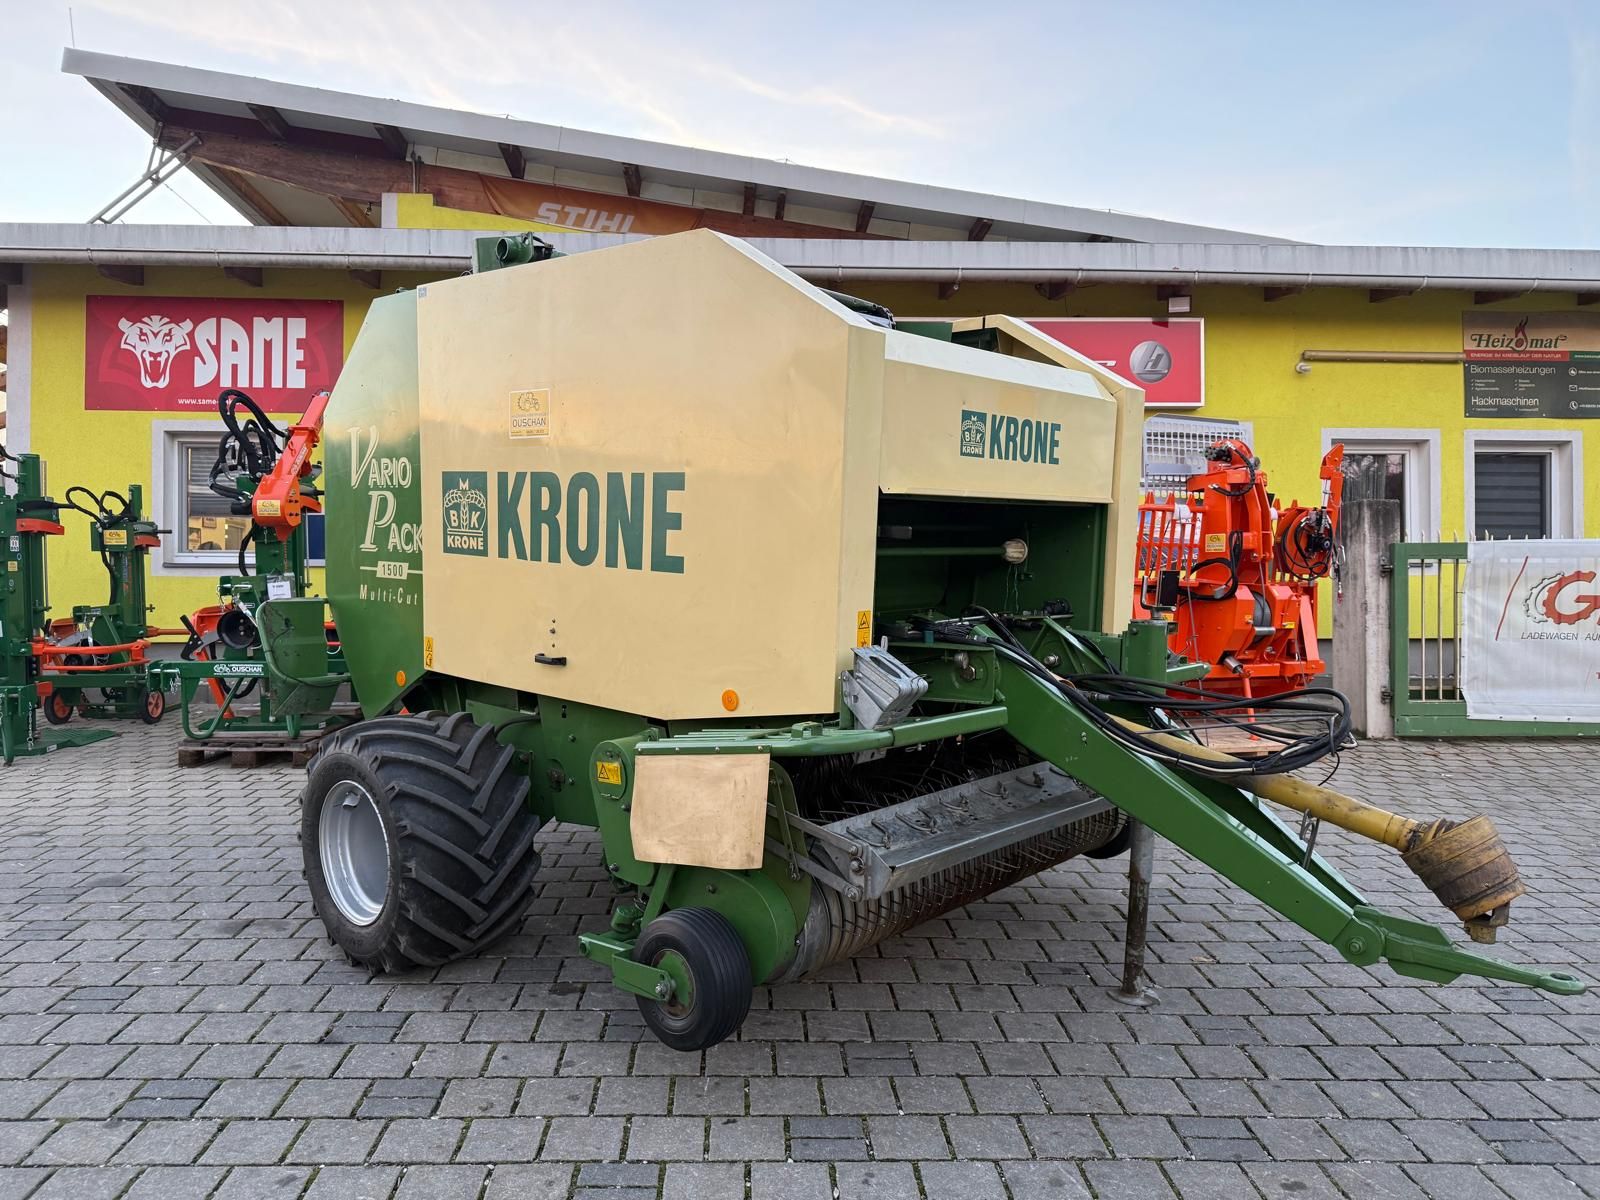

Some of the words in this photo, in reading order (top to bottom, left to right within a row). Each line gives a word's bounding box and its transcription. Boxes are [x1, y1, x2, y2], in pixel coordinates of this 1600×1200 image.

[194, 317, 306, 389] SAME
[1470, 365, 1556, 375] Biomasseheizungen
[1471, 396, 1539, 406] Hackmaschinen
[989, 414, 1061, 465] KRONE
[347, 425, 412, 489] VARIO
[962, 446, 983, 455] KRONE
[497, 471, 685, 574] KRONE
[447, 535, 484, 550] KRONE
[382, 564, 403, 577] 1500
[360, 584, 417, 605] Multi-Cut
[1520, 631, 1579, 641] LADEWAGEN
